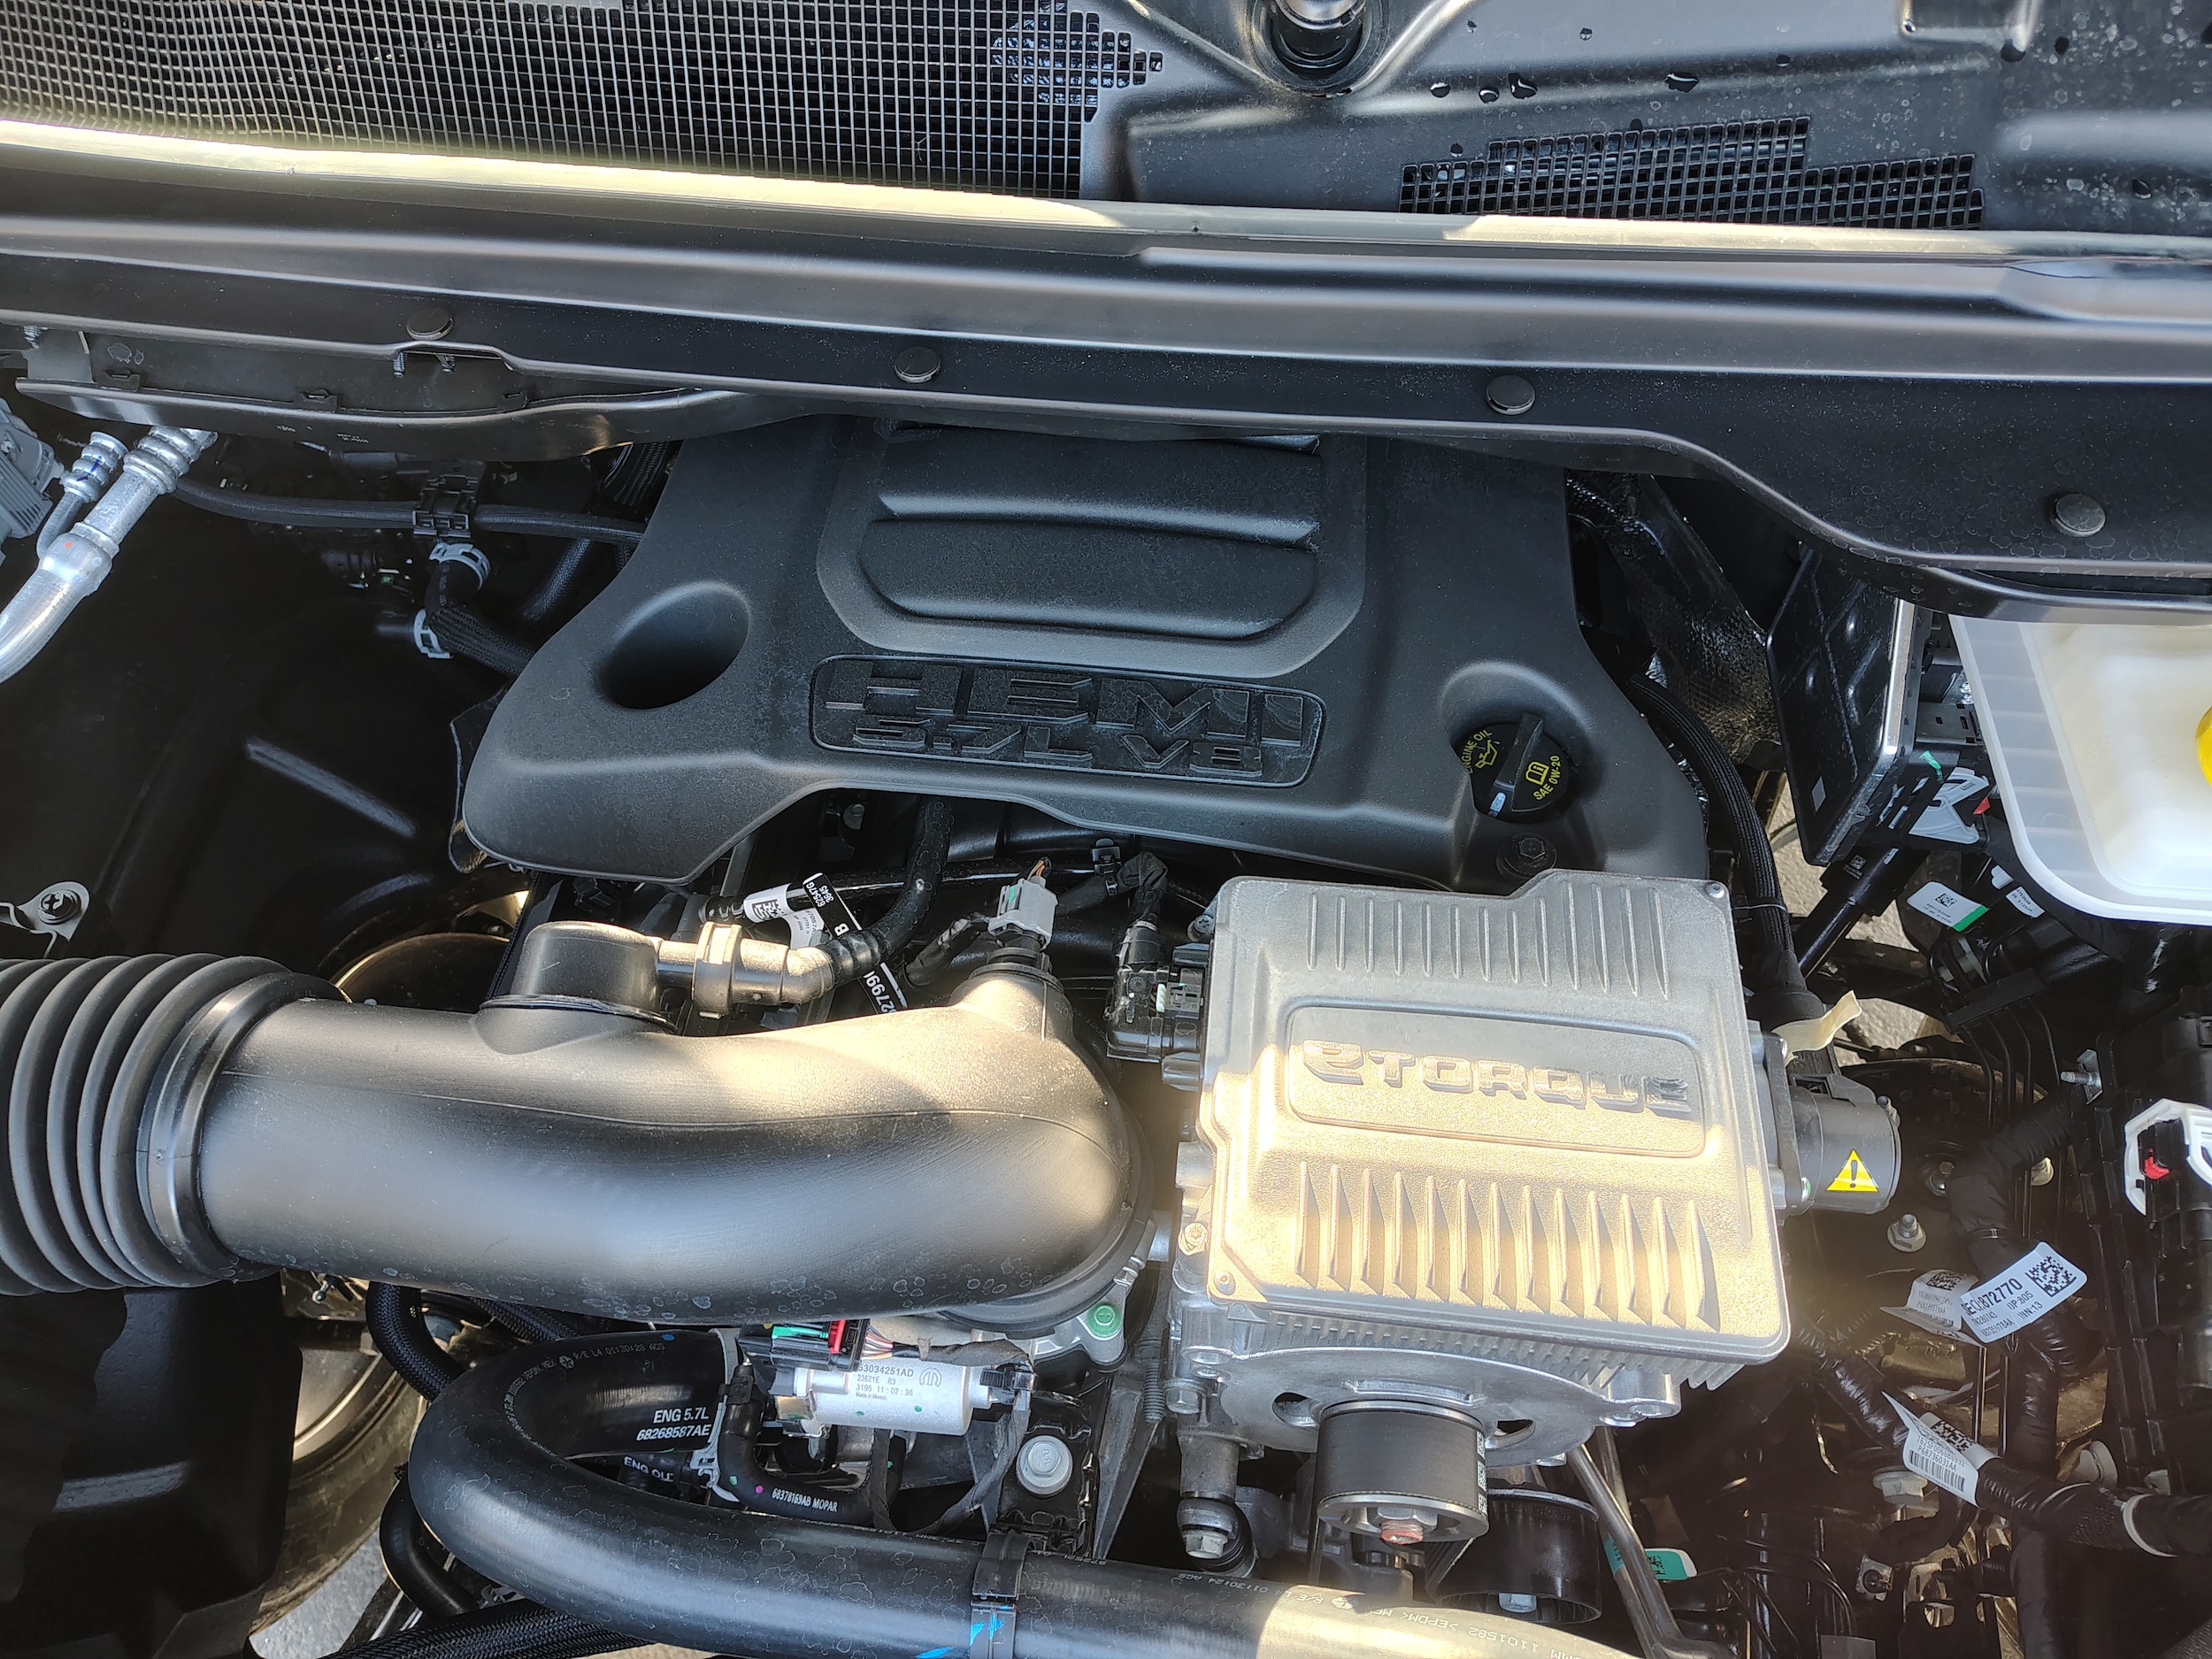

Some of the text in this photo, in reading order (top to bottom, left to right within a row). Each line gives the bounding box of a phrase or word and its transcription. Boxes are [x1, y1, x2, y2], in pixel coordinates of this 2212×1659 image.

[825, 658, 1304, 748] HEMI
[1473, 729, 1493, 741] OIL
[852, 717, 1263, 778] 5.7L V8
[1532, 756, 1562, 801] SAE 0W-20
[805, 881, 826, 908] 62547G
[818, 885, 834, 903] 3645
[1302, 1038, 1692, 1115] eTORQUE
[653, 1407, 710, 1424] ENG 5.7L
[636, 1424, 712, 1441] 68268587AE
[811, 1497, 838, 1512] MOPAR
[1297, 1594, 1325, 1604] R/E
[1400, 1611, 1459, 1632] >EPDM<
[1468, 1626, 1539, 1653] 1101582
